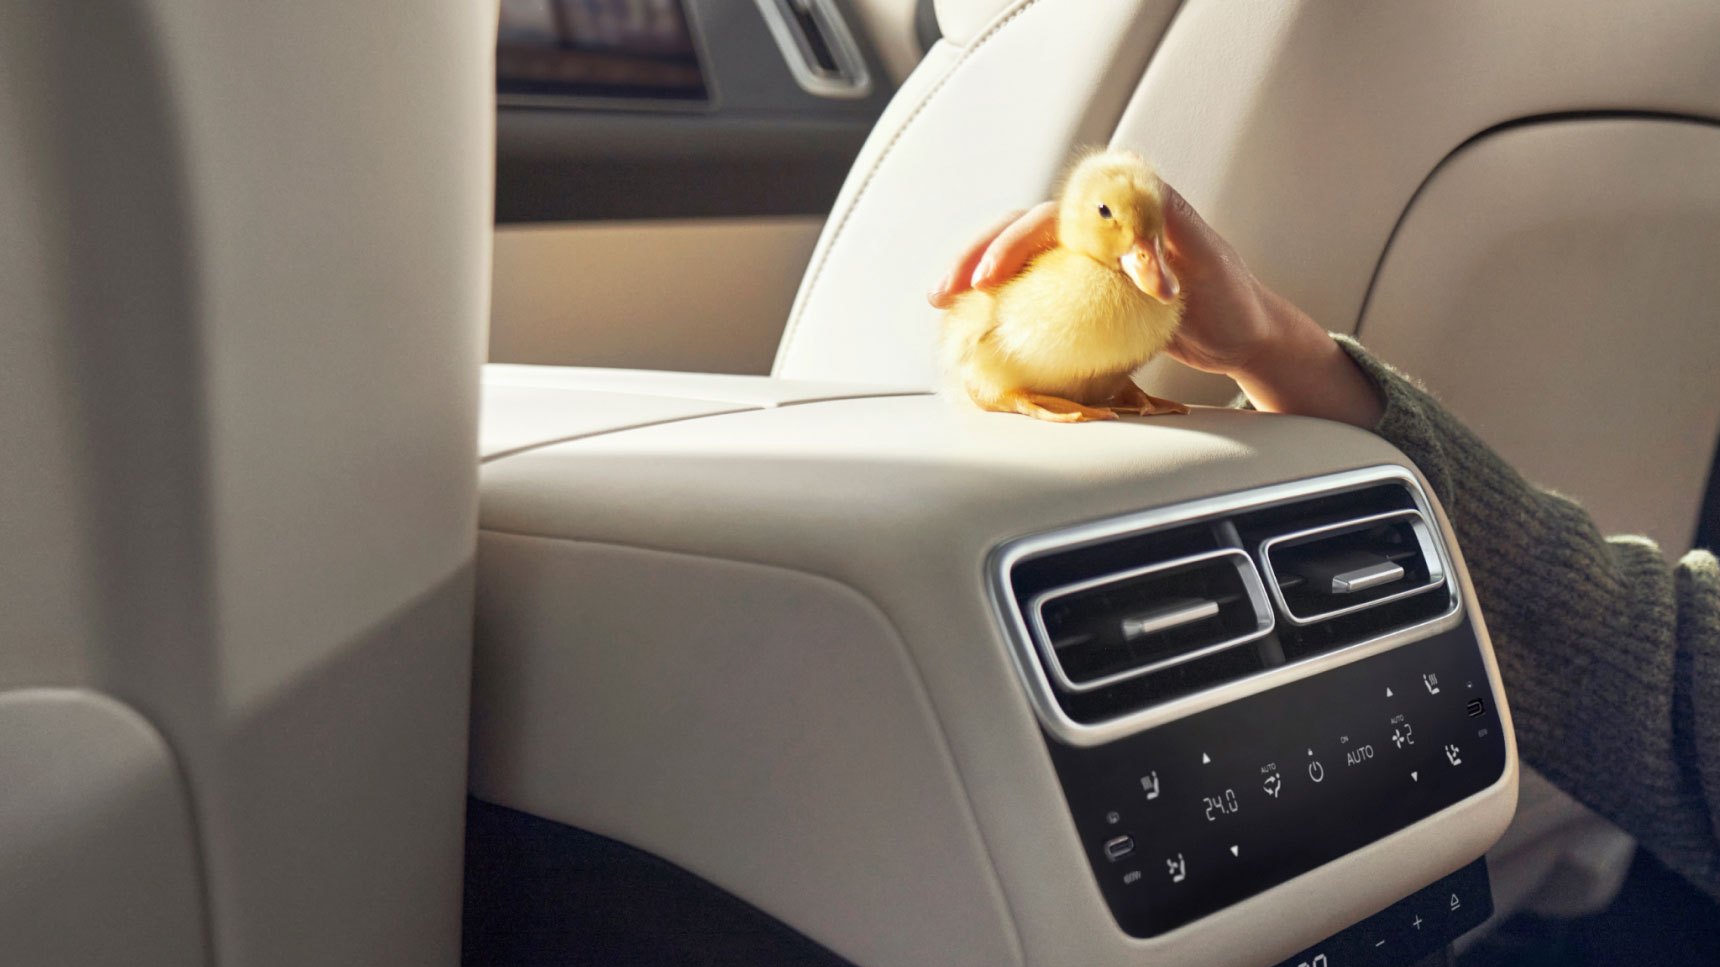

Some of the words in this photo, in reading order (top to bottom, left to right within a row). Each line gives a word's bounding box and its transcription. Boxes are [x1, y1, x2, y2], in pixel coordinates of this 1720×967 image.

[1403, 723, 1415, 745] 2
[1346, 744, 1374, 767] AUTO
[1260, 762, 1277, 775] AUTO
[1202, 788, 1239, 821] 24.0
